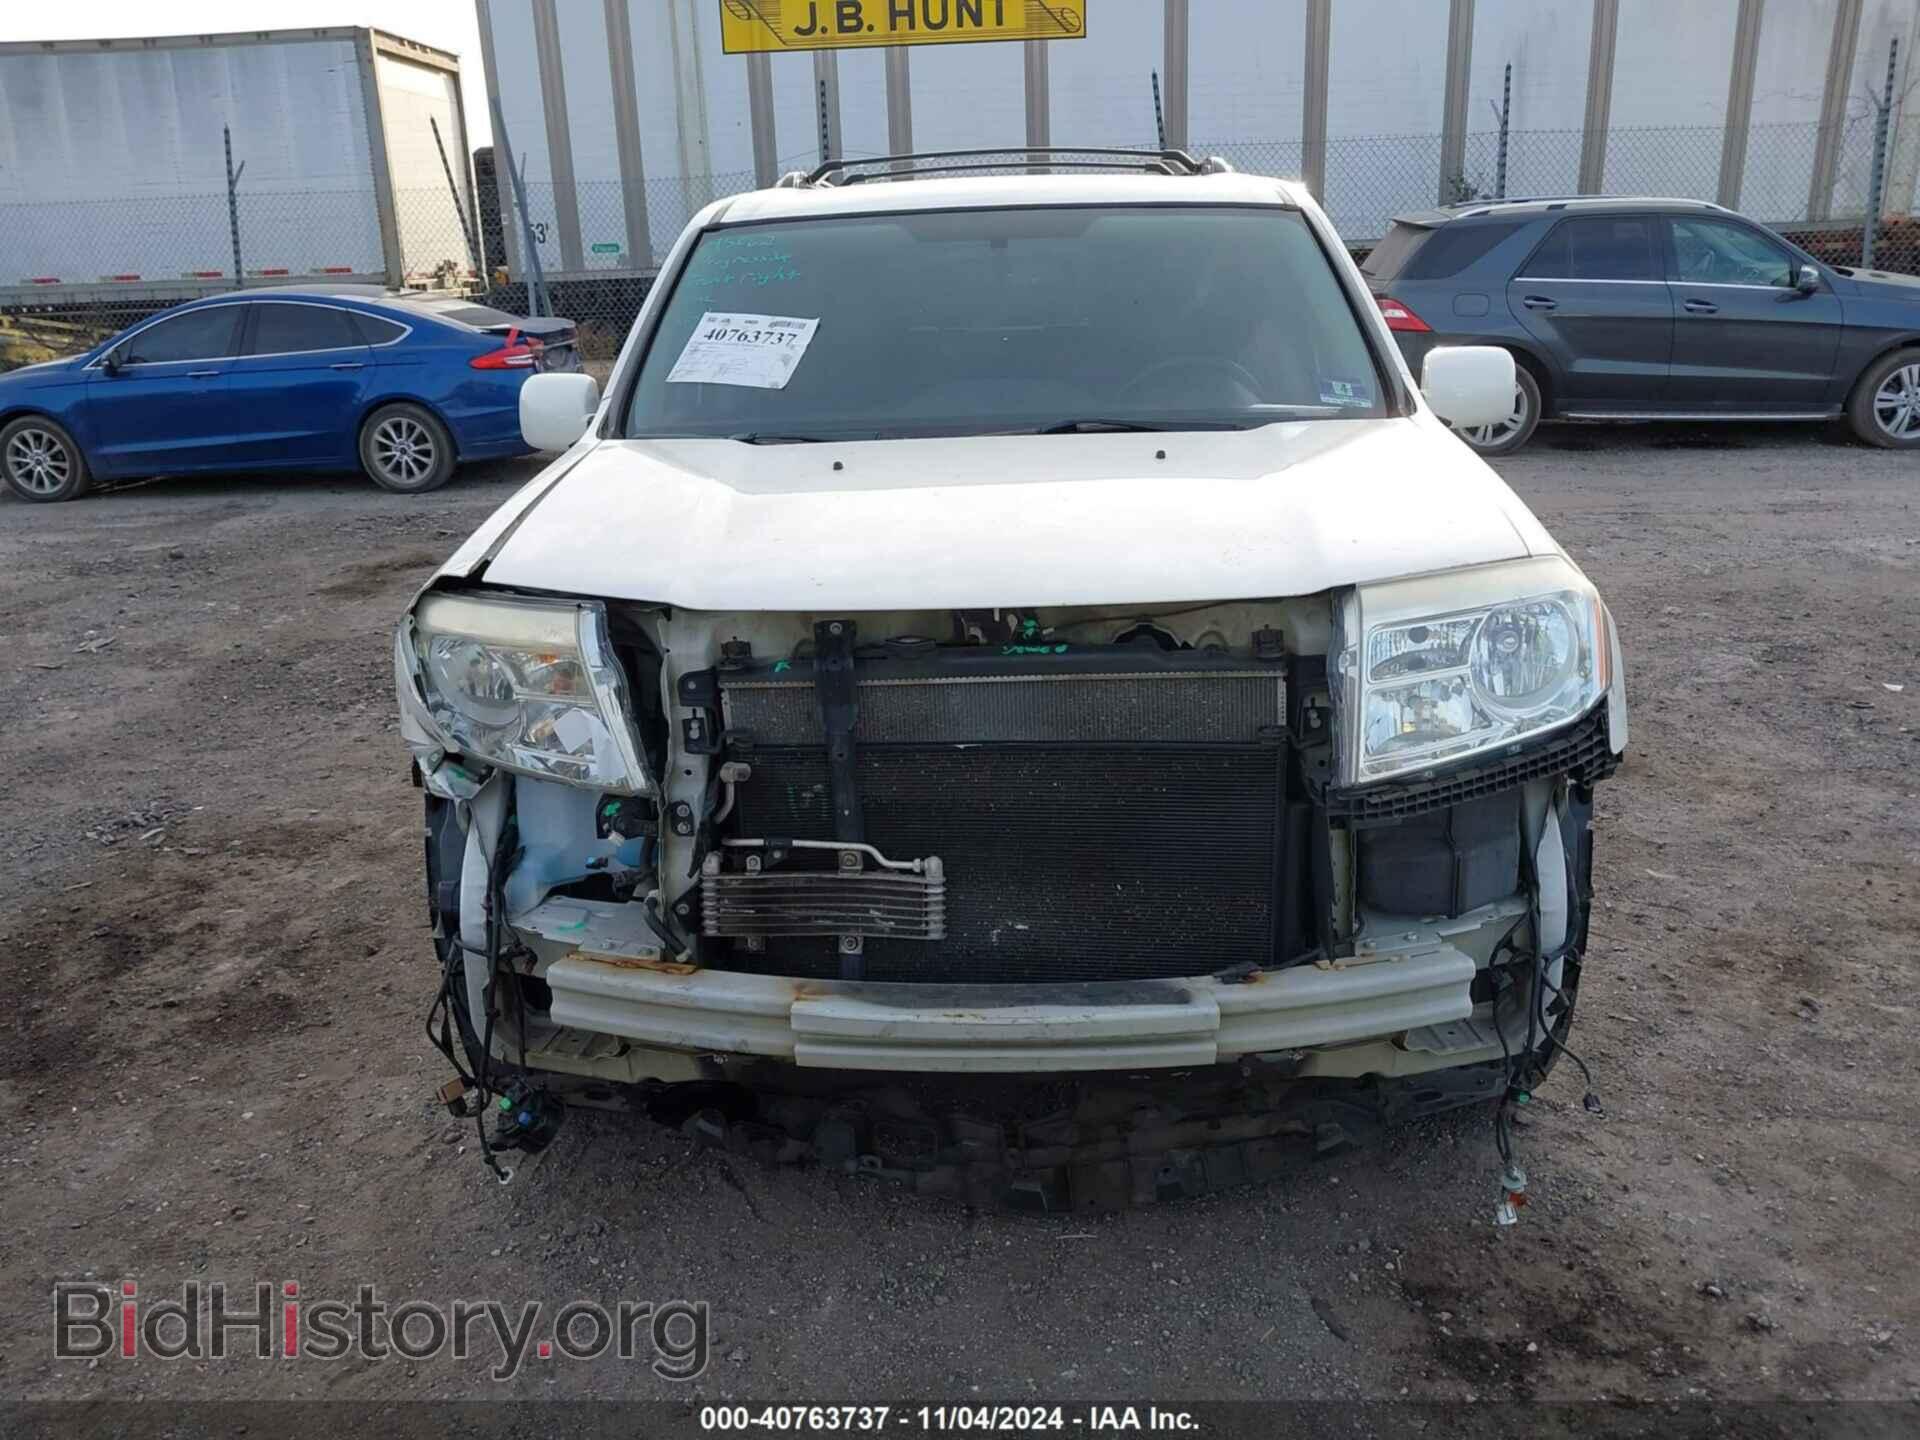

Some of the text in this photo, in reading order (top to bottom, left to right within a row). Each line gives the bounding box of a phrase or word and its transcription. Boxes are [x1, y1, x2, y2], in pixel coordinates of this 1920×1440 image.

[794, 0, 1005, 36] J.B. HUNT
[703, 327, 798, 346] 40763737
